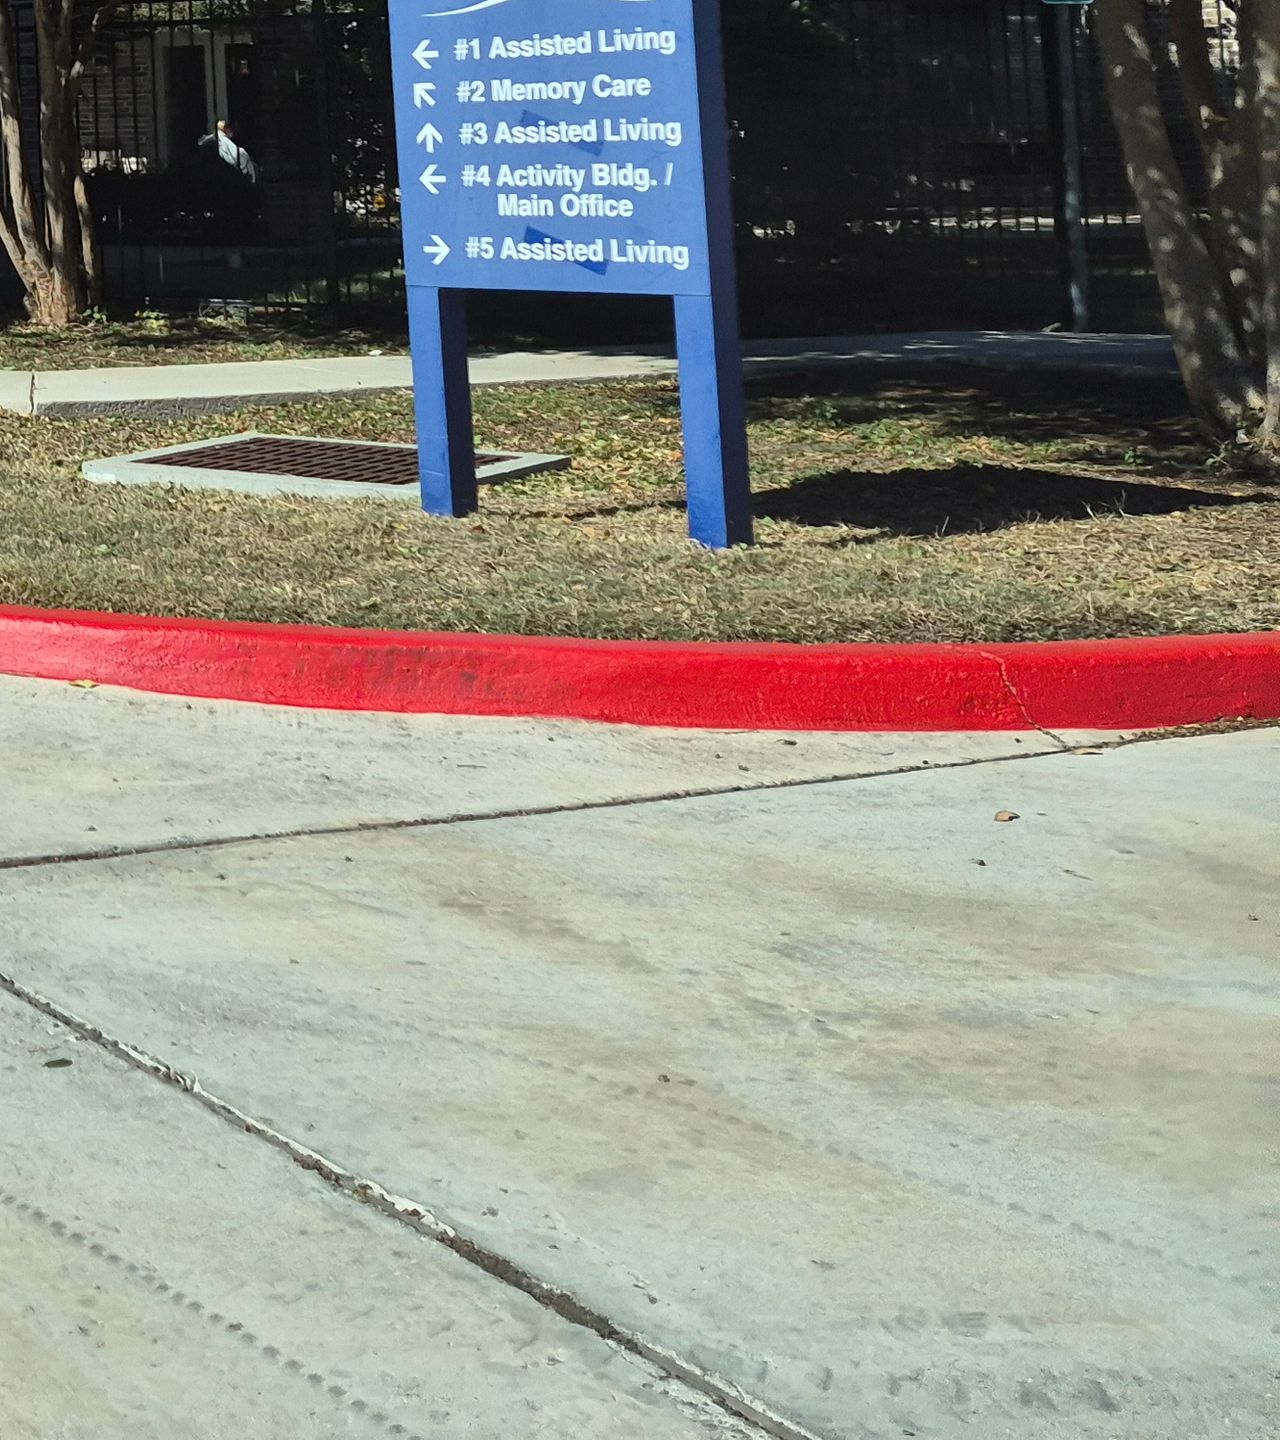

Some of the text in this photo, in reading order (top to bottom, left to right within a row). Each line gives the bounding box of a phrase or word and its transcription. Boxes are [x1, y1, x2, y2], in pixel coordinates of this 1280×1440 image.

[453, 27, 676, 60] #1 Assisted Living
[456, 73, 652, 105] #2 Memory Care
[458, 117, 682, 147] #3 Assisted Living
[460, 162, 674, 192] #4 Activity Bldg. /
[497, 193, 634, 217] Main Office
[465, 236, 689, 270] #5 Assisted Living
